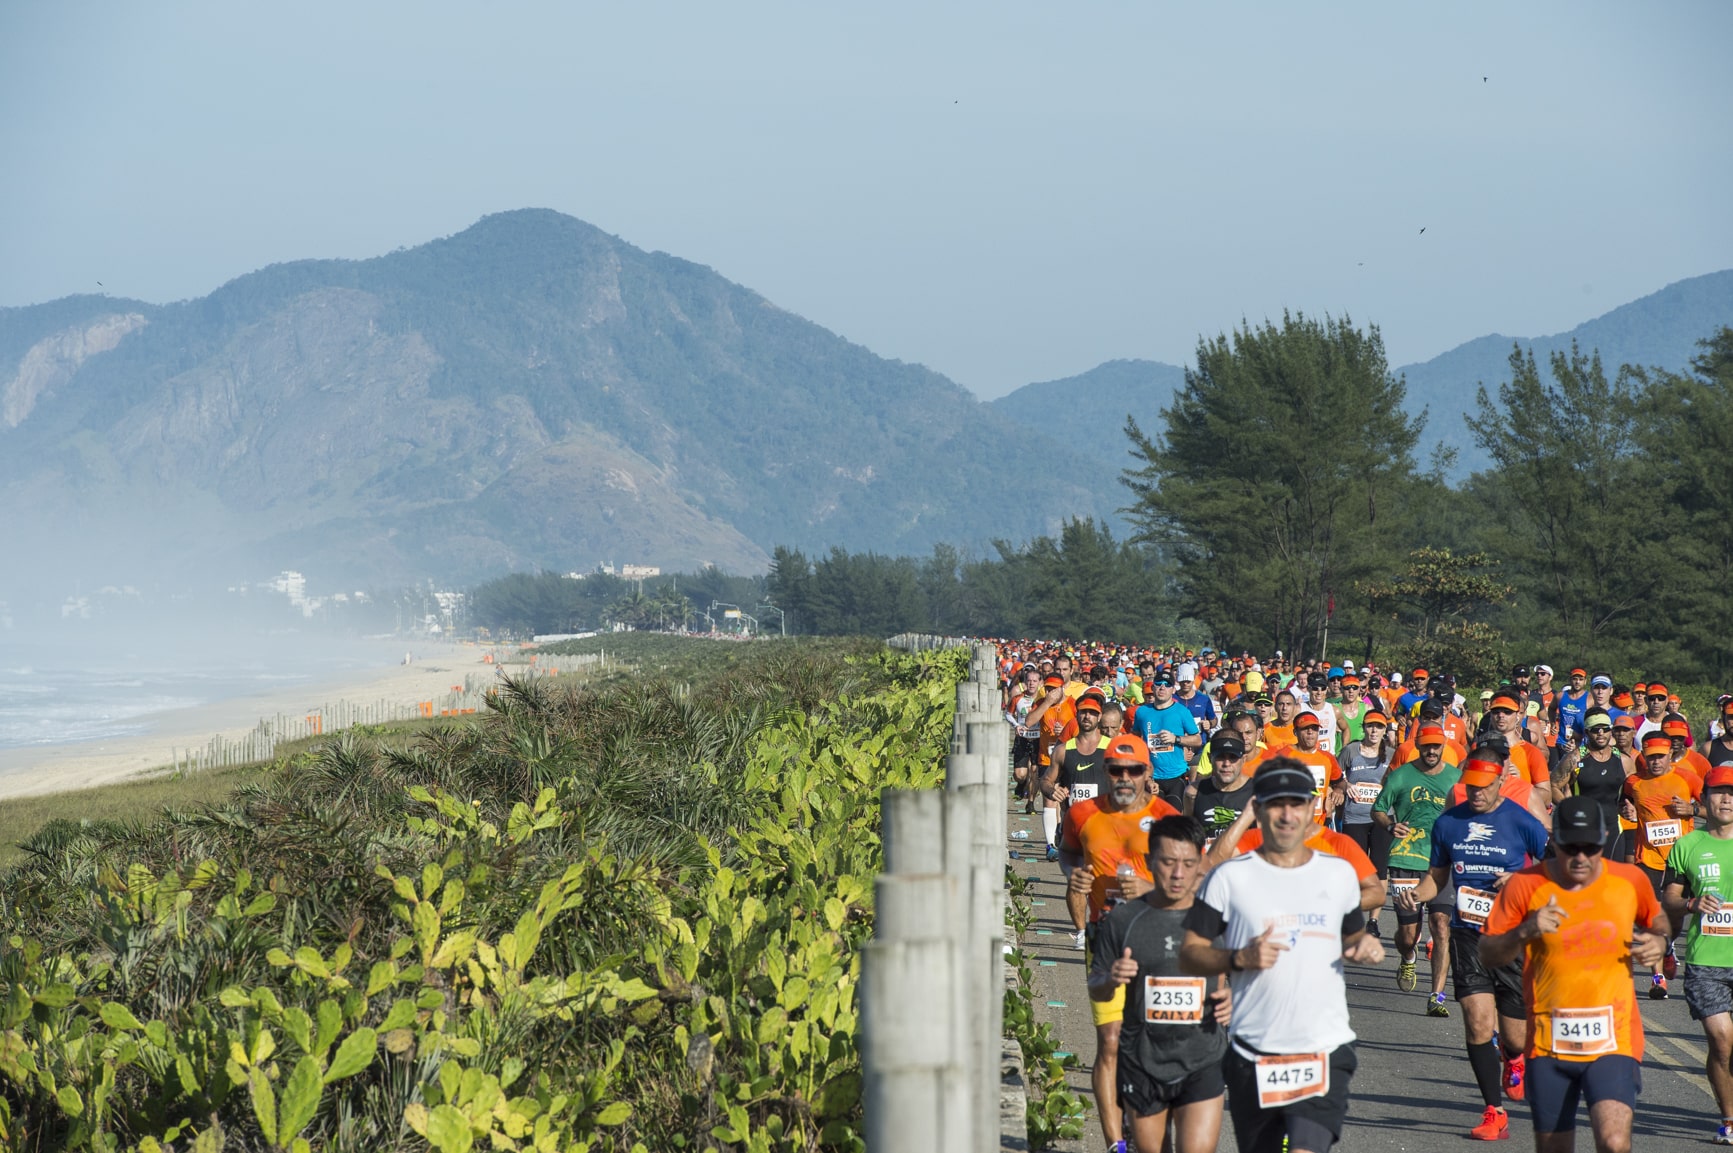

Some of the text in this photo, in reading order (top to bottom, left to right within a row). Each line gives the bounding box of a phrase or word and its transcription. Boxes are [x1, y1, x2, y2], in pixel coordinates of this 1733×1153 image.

[1073, 789, 1090, 798] 198
[1653, 826, 1676, 837] 1554
[1480, 844, 1507, 856] Running
[1465, 865, 1505, 873] UNIVERSO
[1467, 898, 1491, 913] 763
[1152, 991, 1194, 1006] 2353
[1151, 1010, 1195, 1020] CAIXA
[1560, 1022, 1601, 1037] 3418
[1266, 1067, 1314, 1086] 4475
